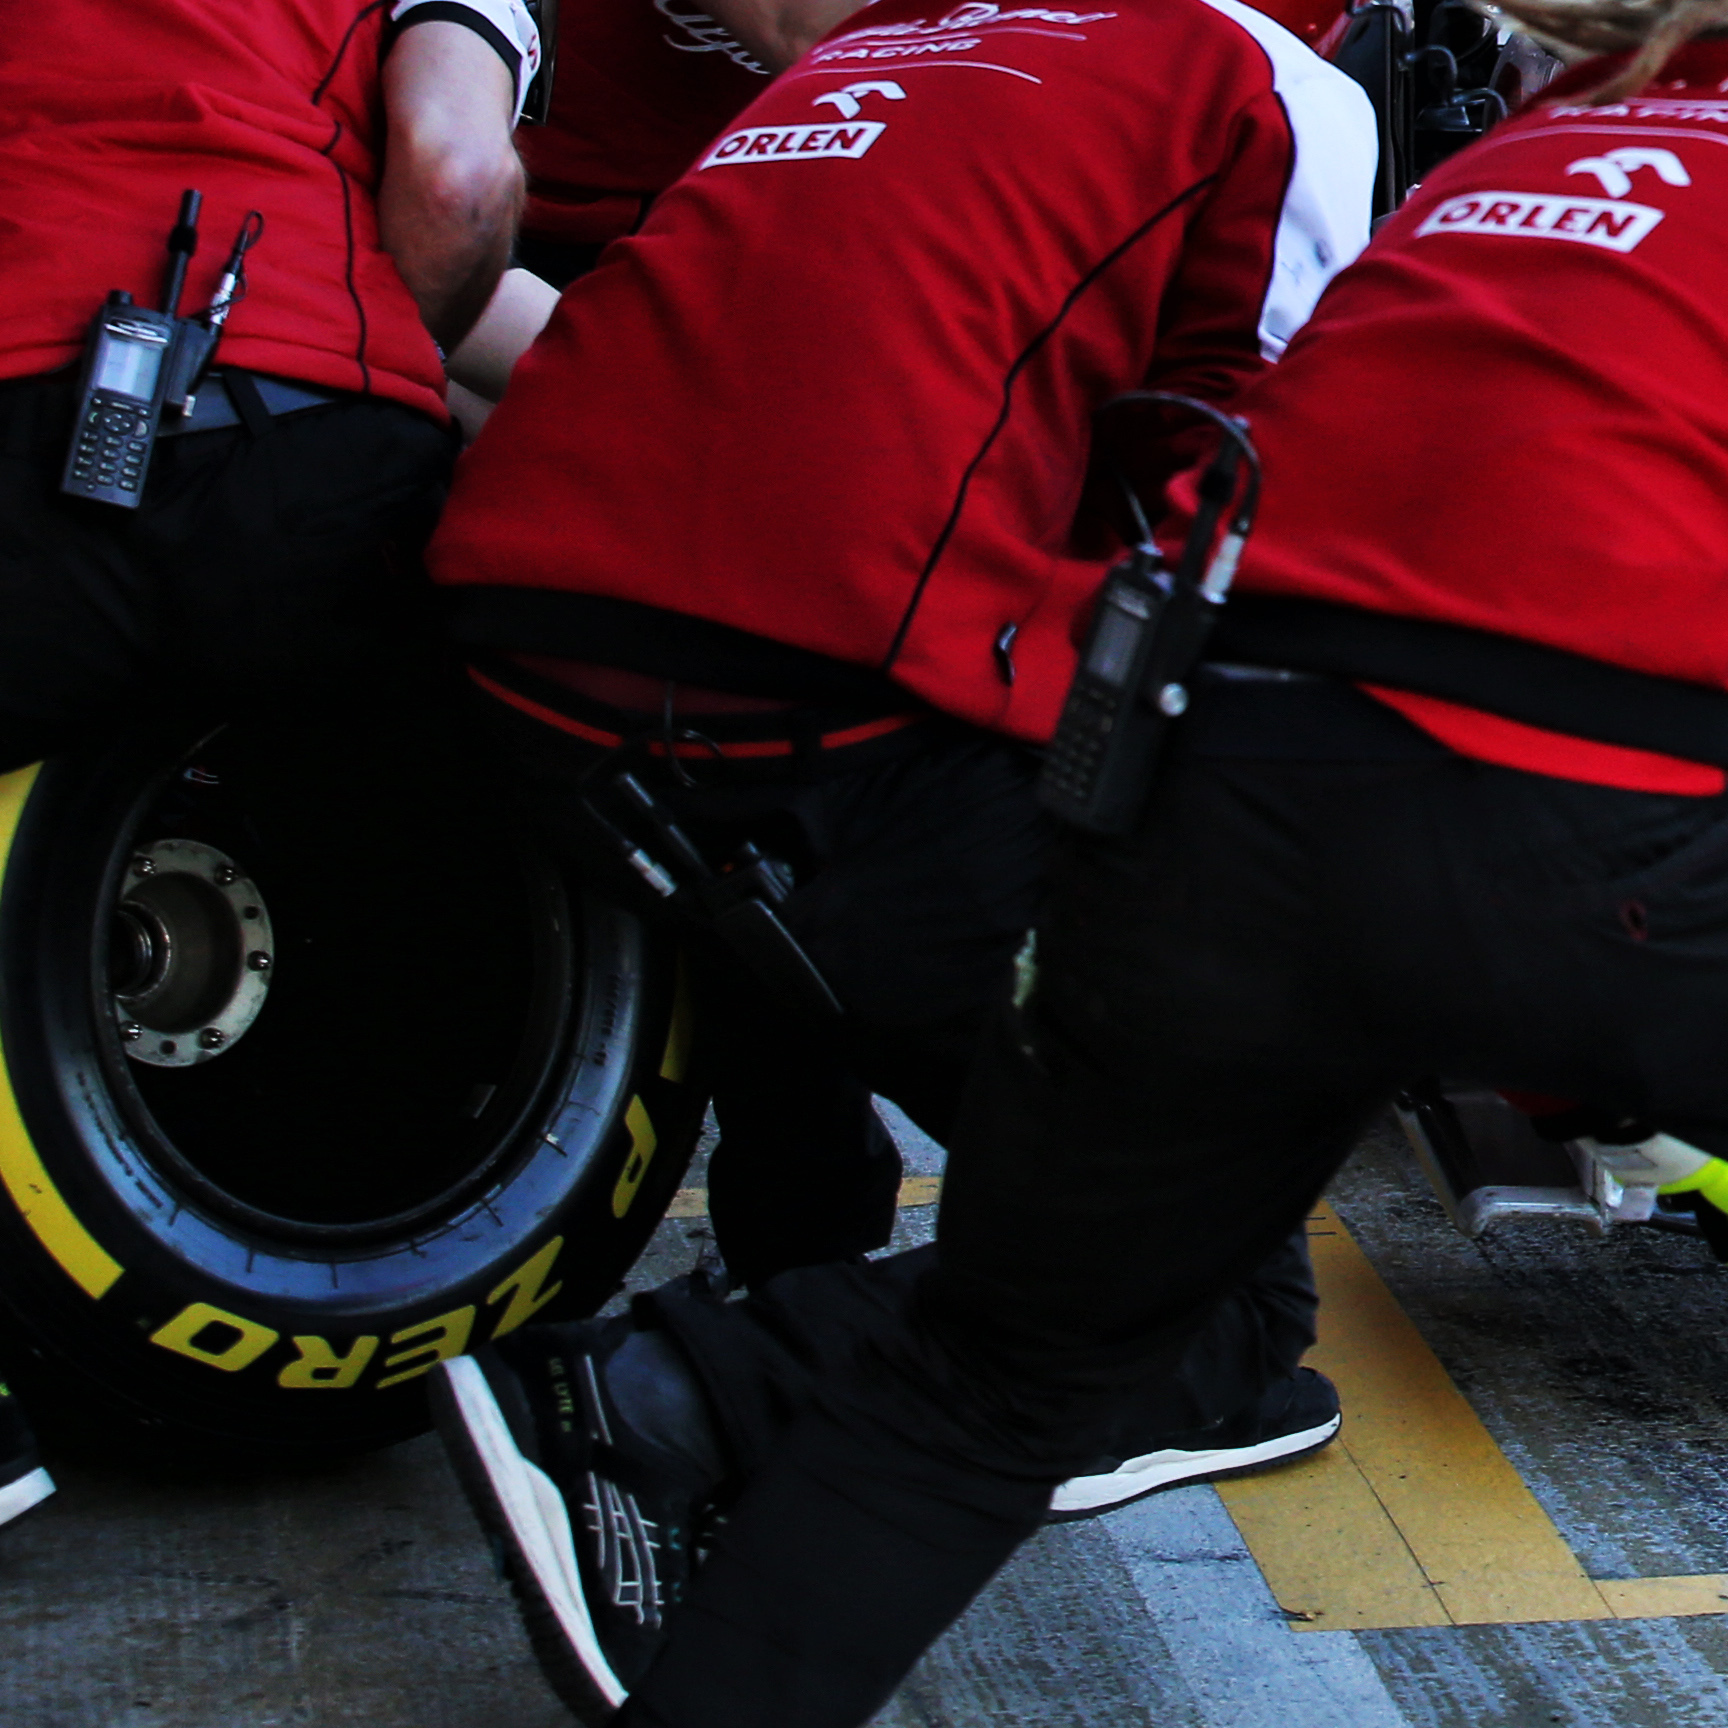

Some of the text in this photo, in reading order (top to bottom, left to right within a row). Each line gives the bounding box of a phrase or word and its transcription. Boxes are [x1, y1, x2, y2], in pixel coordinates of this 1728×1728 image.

[818, 39, 982, 63] RACING
[715, 128, 867, 159] ORLEN
[1442, 201, 1636, 238] ORLEN
[149, 1234, 565, 1389] ZERO
